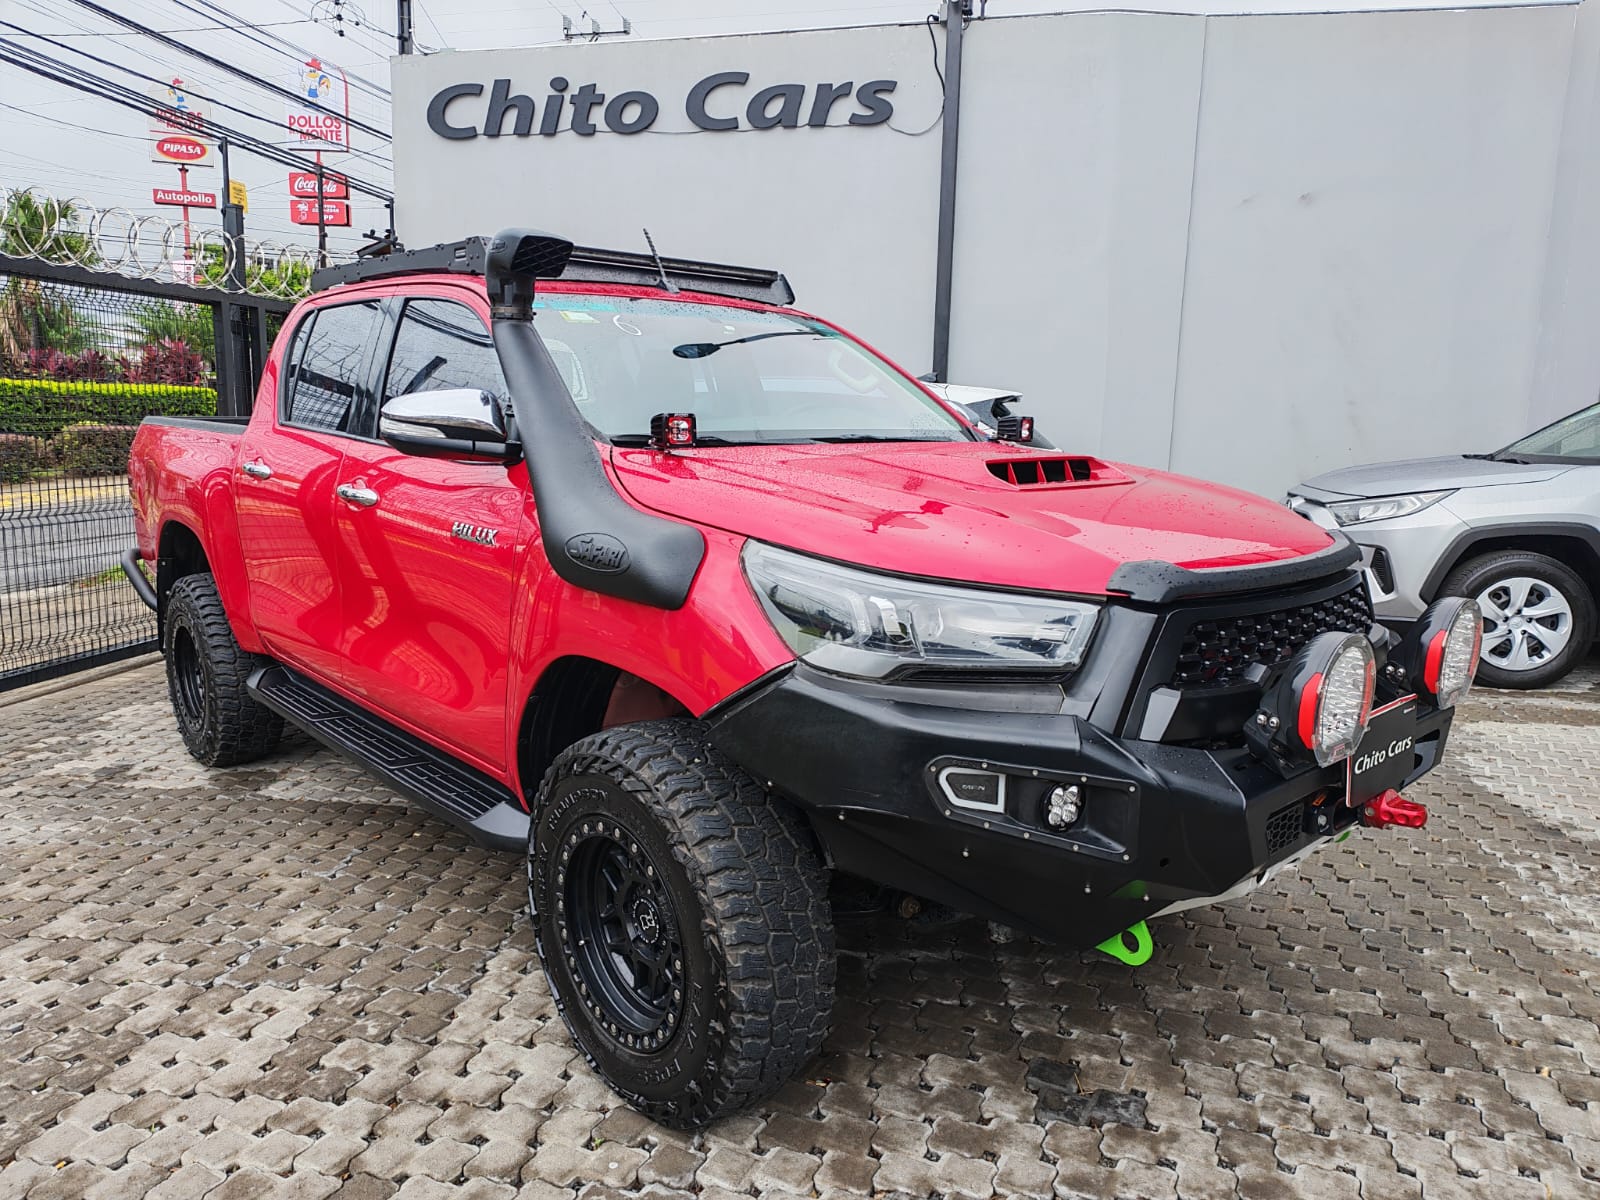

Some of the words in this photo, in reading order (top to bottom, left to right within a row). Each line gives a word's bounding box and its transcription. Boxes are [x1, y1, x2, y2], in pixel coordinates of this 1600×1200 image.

[427, 77, 659, 140] Chito
[685, 72, 898, 132] Cars
[288, 115, 342, 129] POLLOS
[299, 129, 342, 141] MONTE
[163, 143, 202, 155] PIPASA
[156, 190, 213, 204] Autopollo
[451, 521, 499, 546] HILUX
[1354, 750, 1386, 775] Chito
[1388, 736, 1412, 757] Cars
